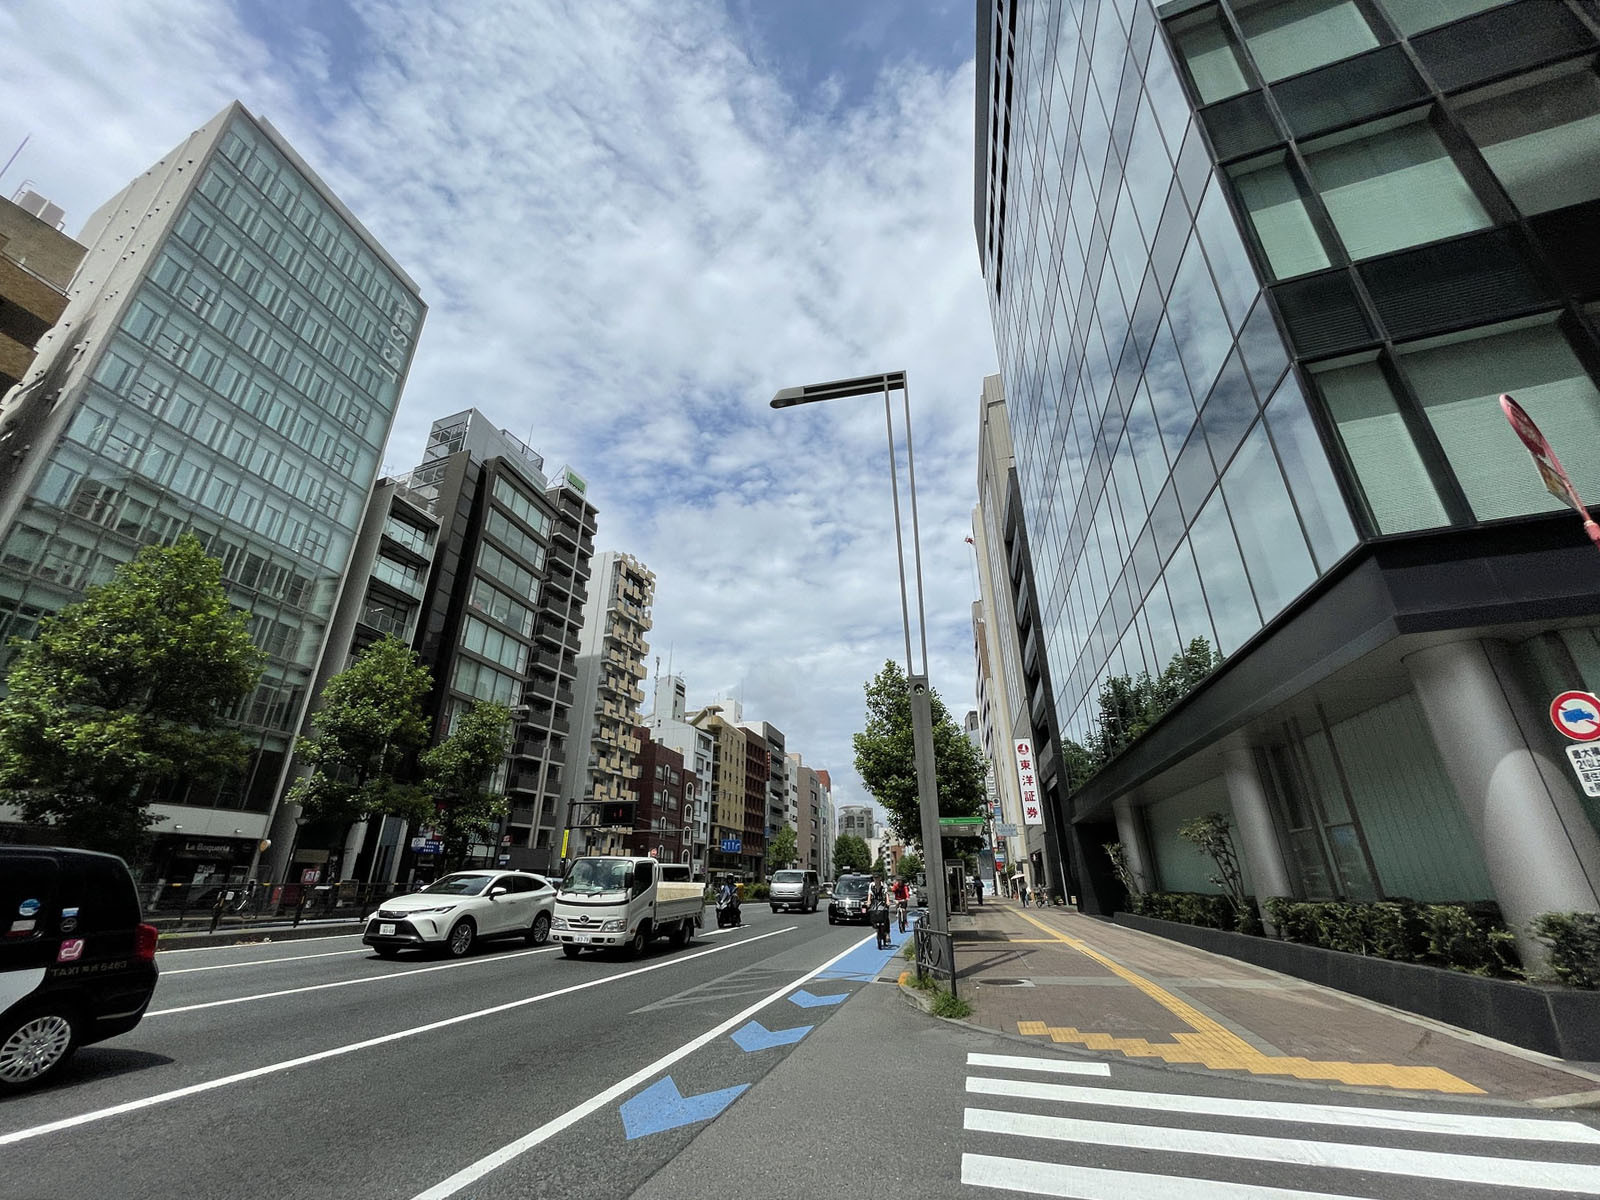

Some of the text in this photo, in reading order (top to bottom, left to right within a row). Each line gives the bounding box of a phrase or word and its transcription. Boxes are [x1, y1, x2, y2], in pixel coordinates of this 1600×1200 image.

[378, 292, 417, 384] ASSIST
[1019, 760, 1038, 818] 東洋証券
[50, 966, 80, 977] TAXI
